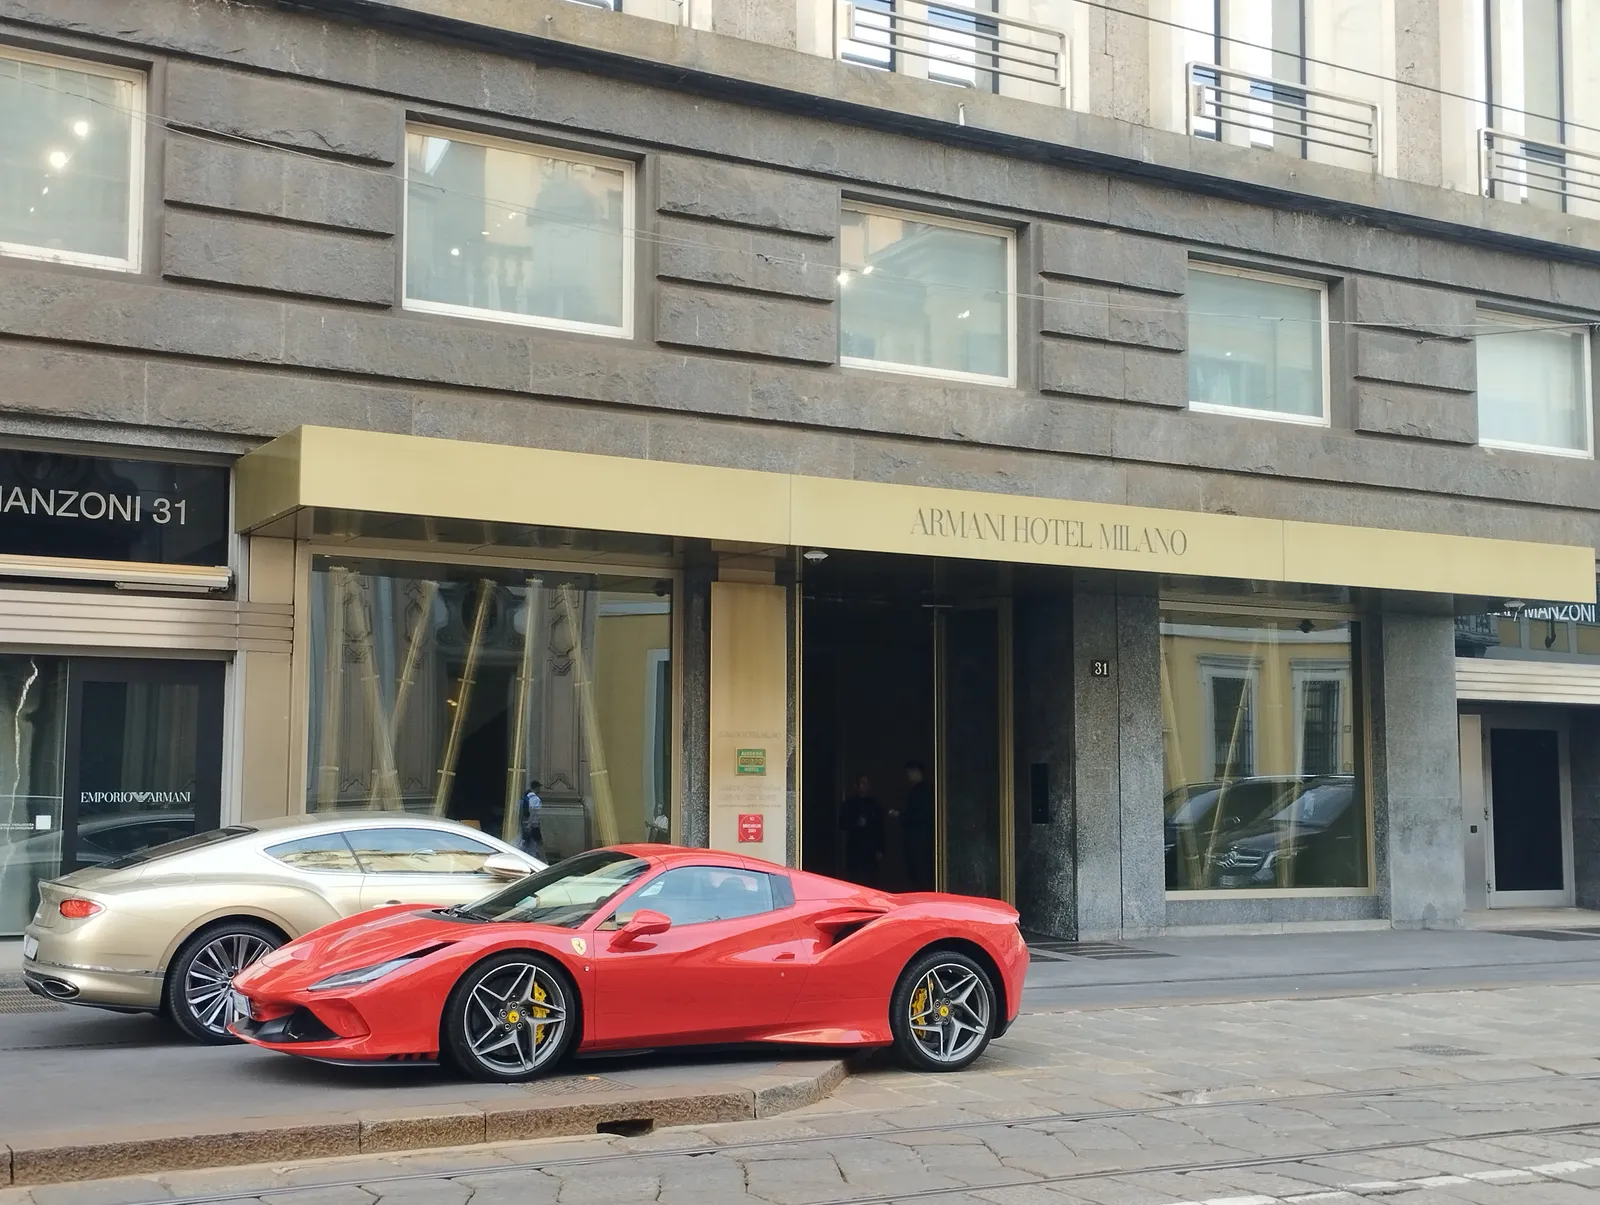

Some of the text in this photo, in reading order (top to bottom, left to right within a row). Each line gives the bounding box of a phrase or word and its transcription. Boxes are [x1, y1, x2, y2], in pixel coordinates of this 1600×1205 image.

[0, 486, 186, 525] ANZONI 31
[910, 507, 1188, 556] ARMANI HOTEL MILANO
[1094, 661, 1107, 675] 31
[80, 791, 191, 803] EMPORIO ARMANI
